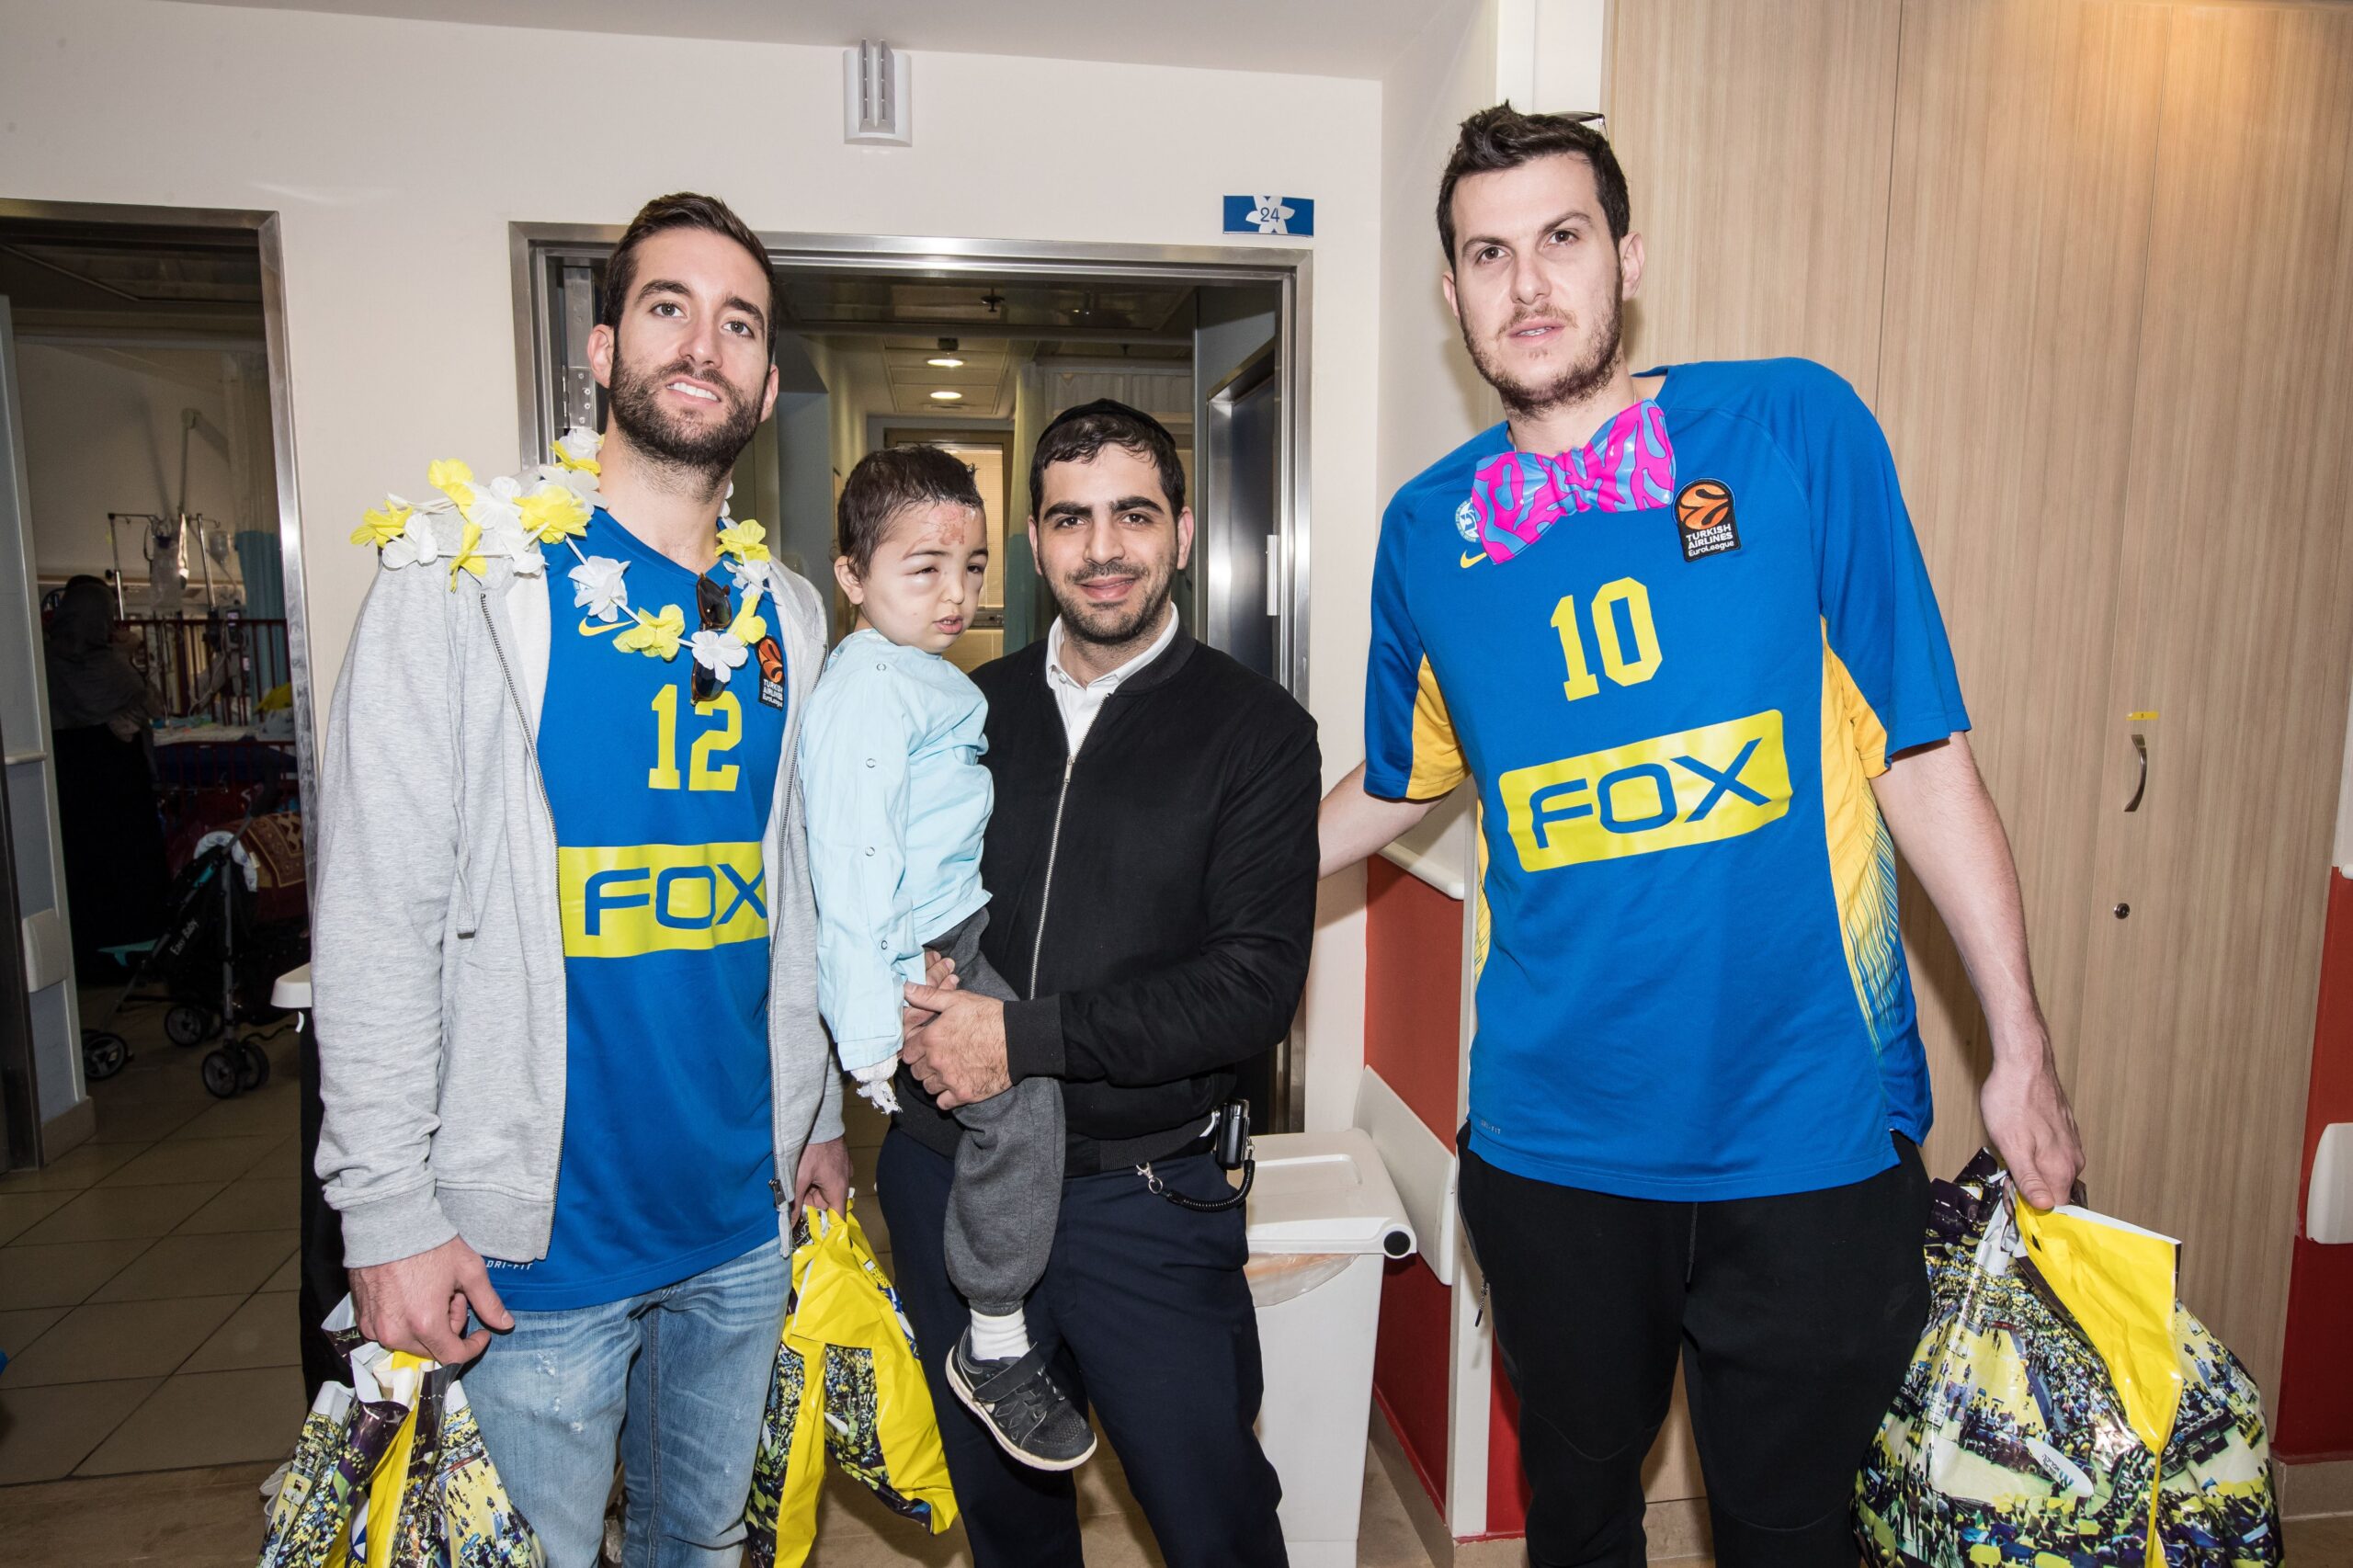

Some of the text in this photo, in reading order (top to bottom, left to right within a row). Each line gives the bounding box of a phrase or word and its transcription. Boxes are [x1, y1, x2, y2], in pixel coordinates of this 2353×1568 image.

[1260, 207, 1280, 222] 24
[1686, 523, 1732, 541] TURKISH
[1688, 531, 1733, 550] AIRLINES
[1688, 540, 1734, 557] EuroLeague
[1551, 576, 1663, 701] 10
[648, 684, 743, 791] 12
[1529, 737, 1772, 849] FOX
[585, 864, 768, 936] FOX
